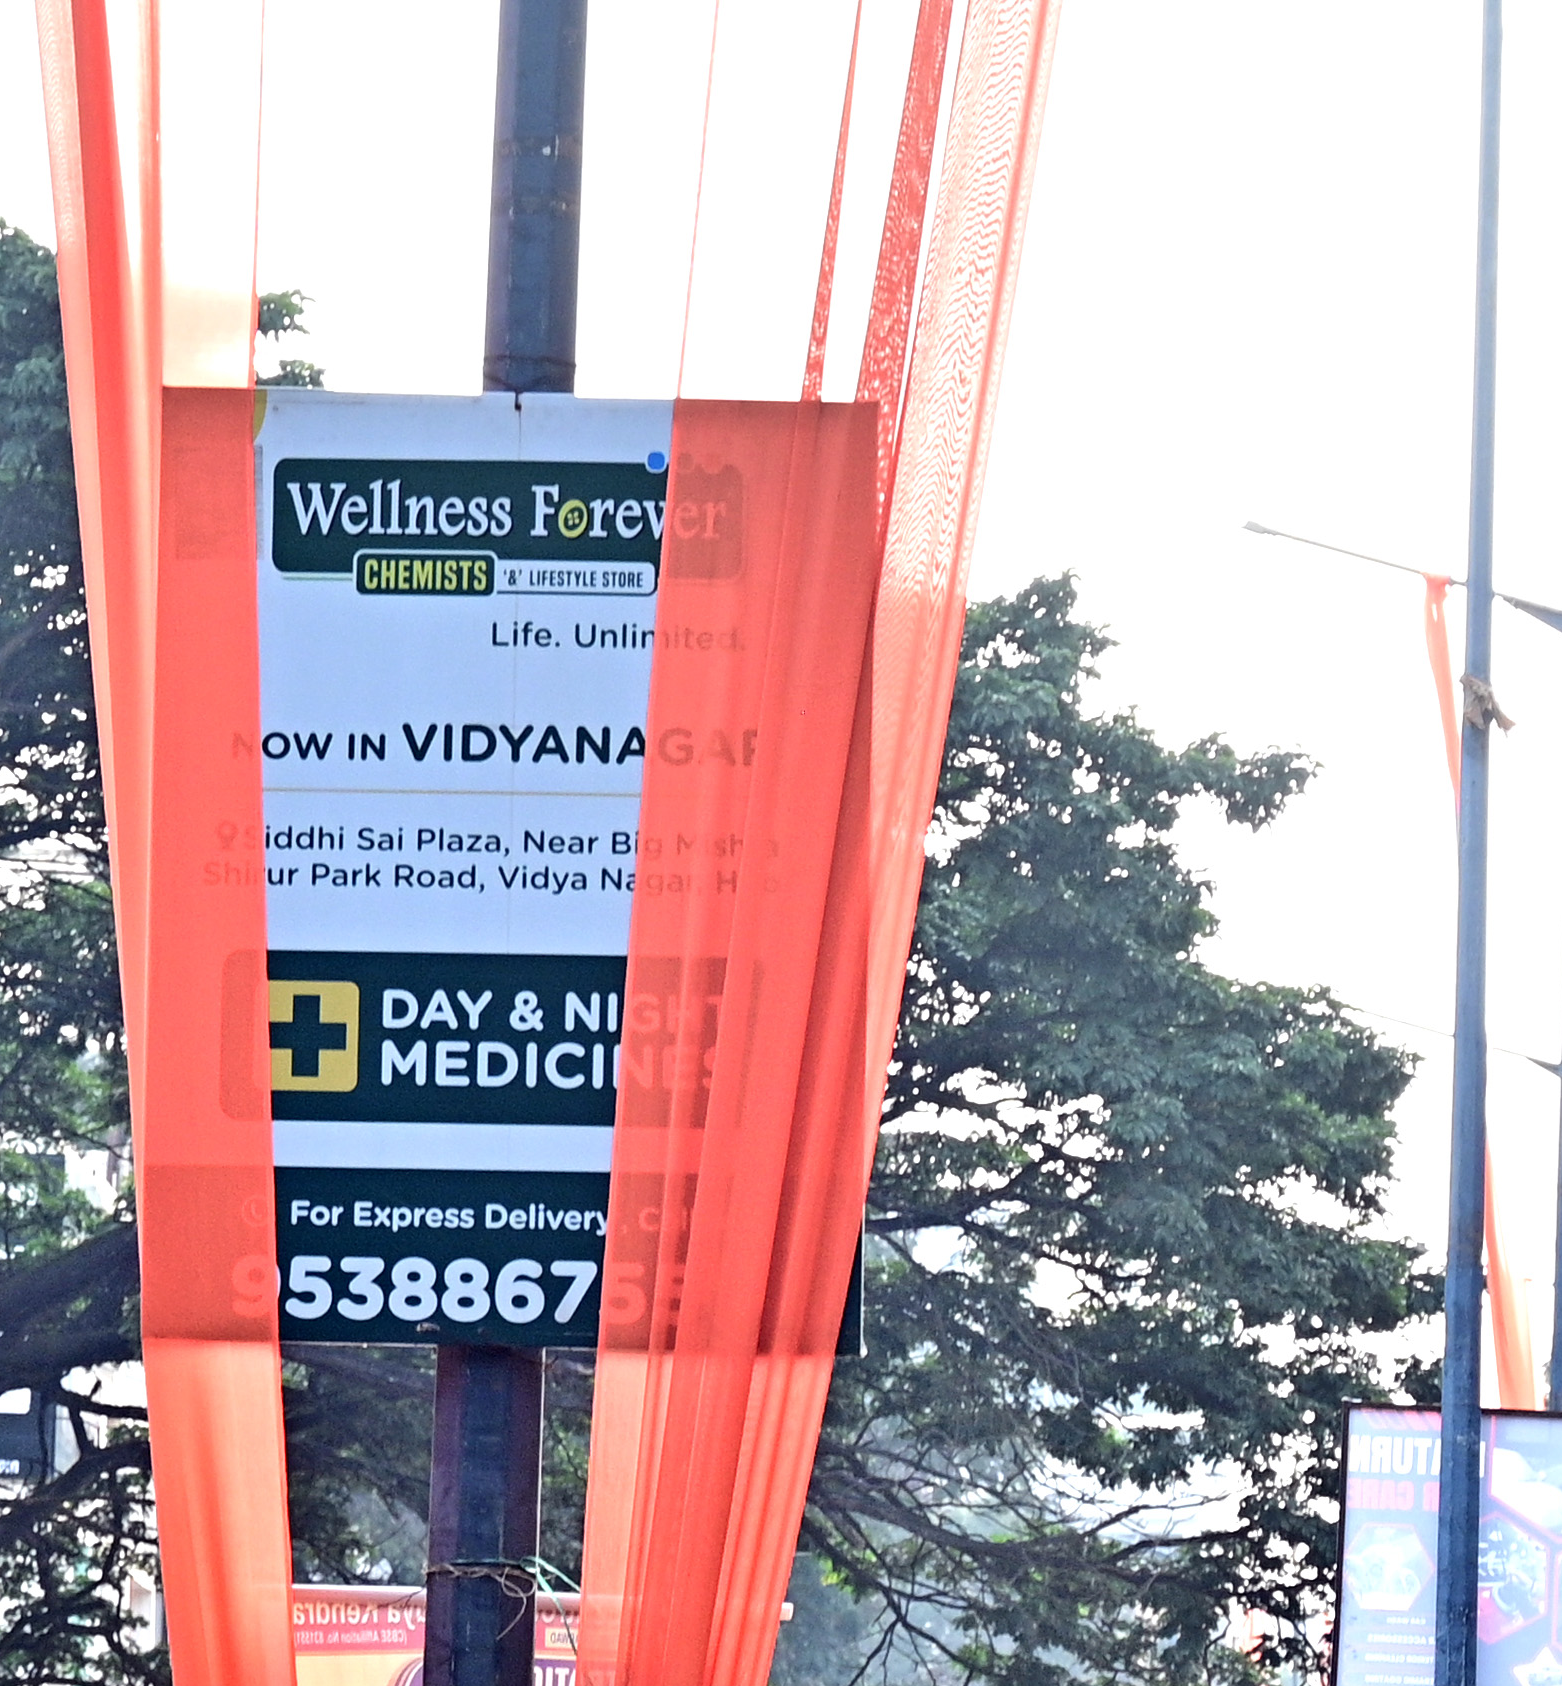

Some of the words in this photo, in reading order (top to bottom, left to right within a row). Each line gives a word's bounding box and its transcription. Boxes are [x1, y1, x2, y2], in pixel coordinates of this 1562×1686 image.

[286, 478, 513, 540] Wellness
[529, 484, 727, 543] Forever
[362, 558, 490, 594] CHEMISTS
[528, 567, 595, 589] LIFESTYLE
[600, 569, 646, 589] STORE
[491, 621, 563, 651] Life.
[346, 732, 387, 763] IN
[355, 826, 406, 853] Sai
[416, 828, 512, 860] Plaza,
[522, 831, 600, 856] Near
[309, 863, 381, 890] Park
[392, 865, 486, 896] Road,
[497, 866, 588, 898] Vidya
[380, 989, 493, 1031] DAY
[509, 990, 545, 1031] &
[290, 1200, 344, 1228] For
[352, 1202, 476, 1236] Express
